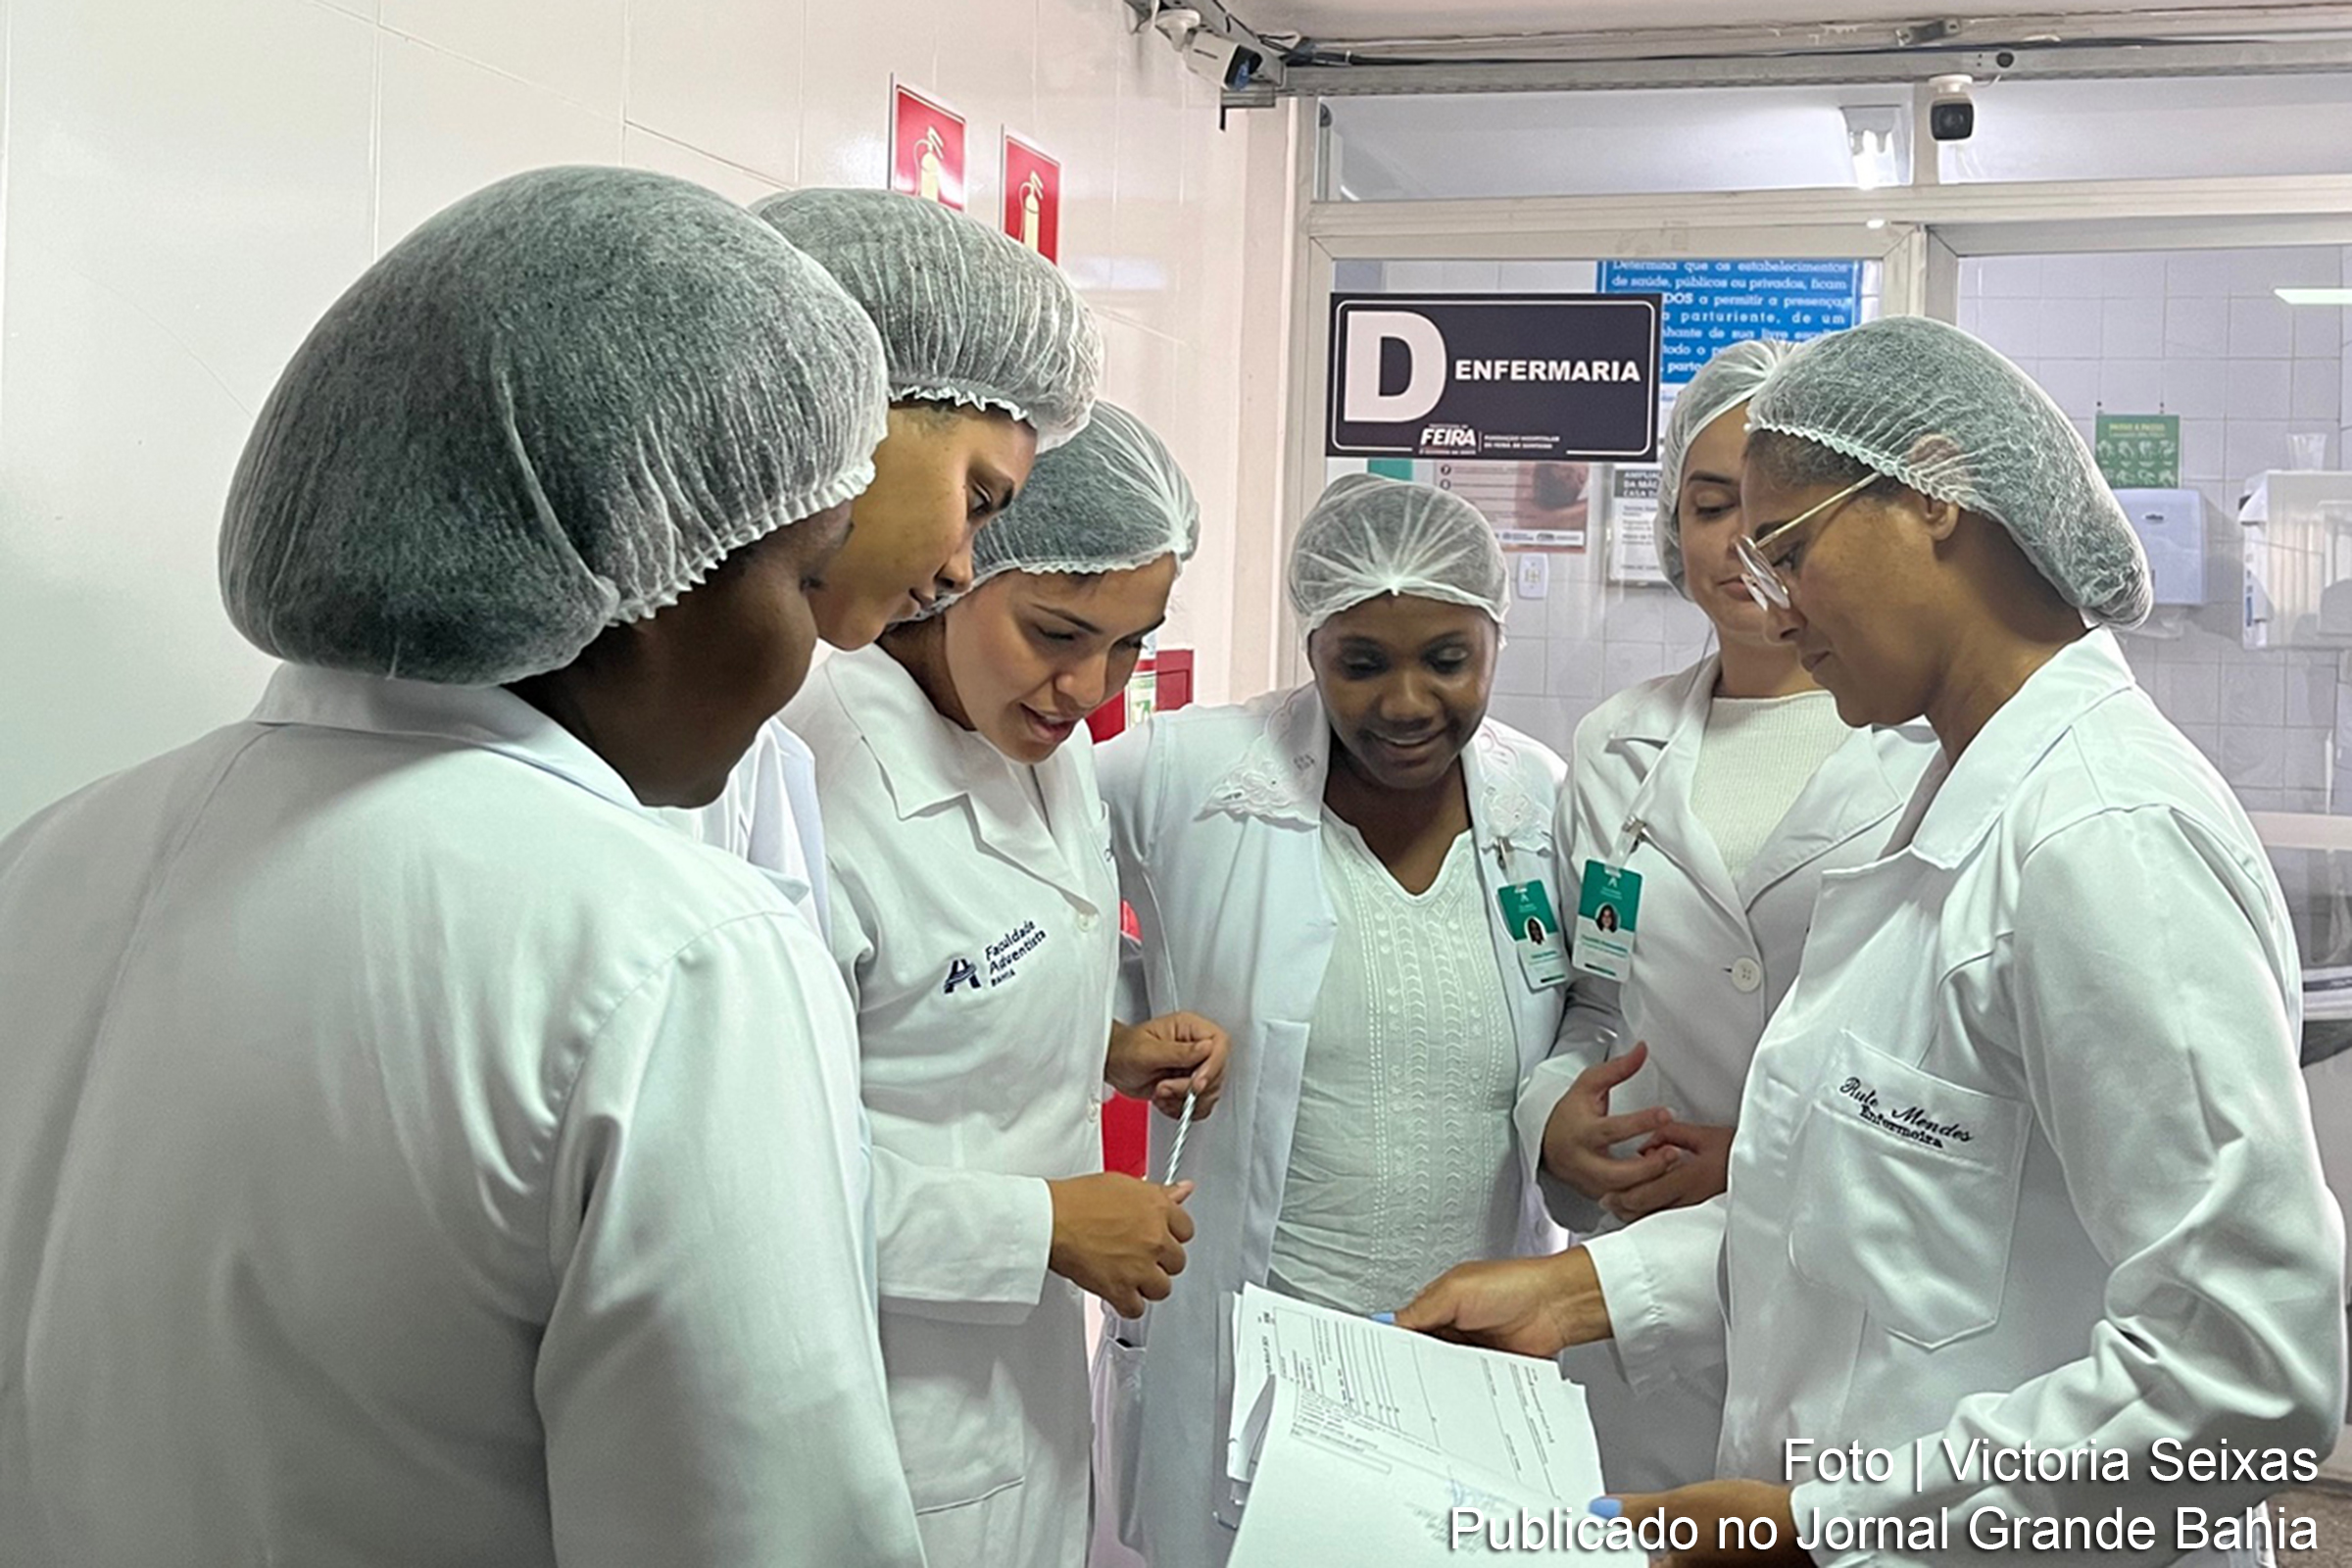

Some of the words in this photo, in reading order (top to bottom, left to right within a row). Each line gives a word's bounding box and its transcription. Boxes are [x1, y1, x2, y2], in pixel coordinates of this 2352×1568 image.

[1613, 260, 1677, 270] Determina
[1684, 262, 1708, 273] que
[1715, 262, 1731, 271] os
[1738, 260, 1848, 272] estabelecimentos
[1611, 274, 1628, 286] de
[1675, 275, 1728, 290] públicos
[1731, 278, 1746, 288] ou
[1811, 278, 1847, 290] ficam
[1662, 292, 1693, 305] DOS
[1698, 296, 1708, 306] a
[1714, 293, 1763, 308] permitir
[1768, 296, 1778, 306] a
[1791, 312, 1811, 324] de
[1822, 314, 1845, 324] um
[1709, 326, 1725, 339] de
[1731, 330, 1754, 339] sua
[1696, 346, 1706, 356] o
[1344, 310, 1447, 423] D
[1454, 360, 1642, 382] ENFERMARIA
[1421, 428, 1477, 447] FEIRA
[985, 920, 1036, 961] Faculdade
[990, 929, 1047, 975] Adventista
[1859, 1103, 1943, 1149] Enfermeira
[1891, 1106, 1974, 1142] Mendes
